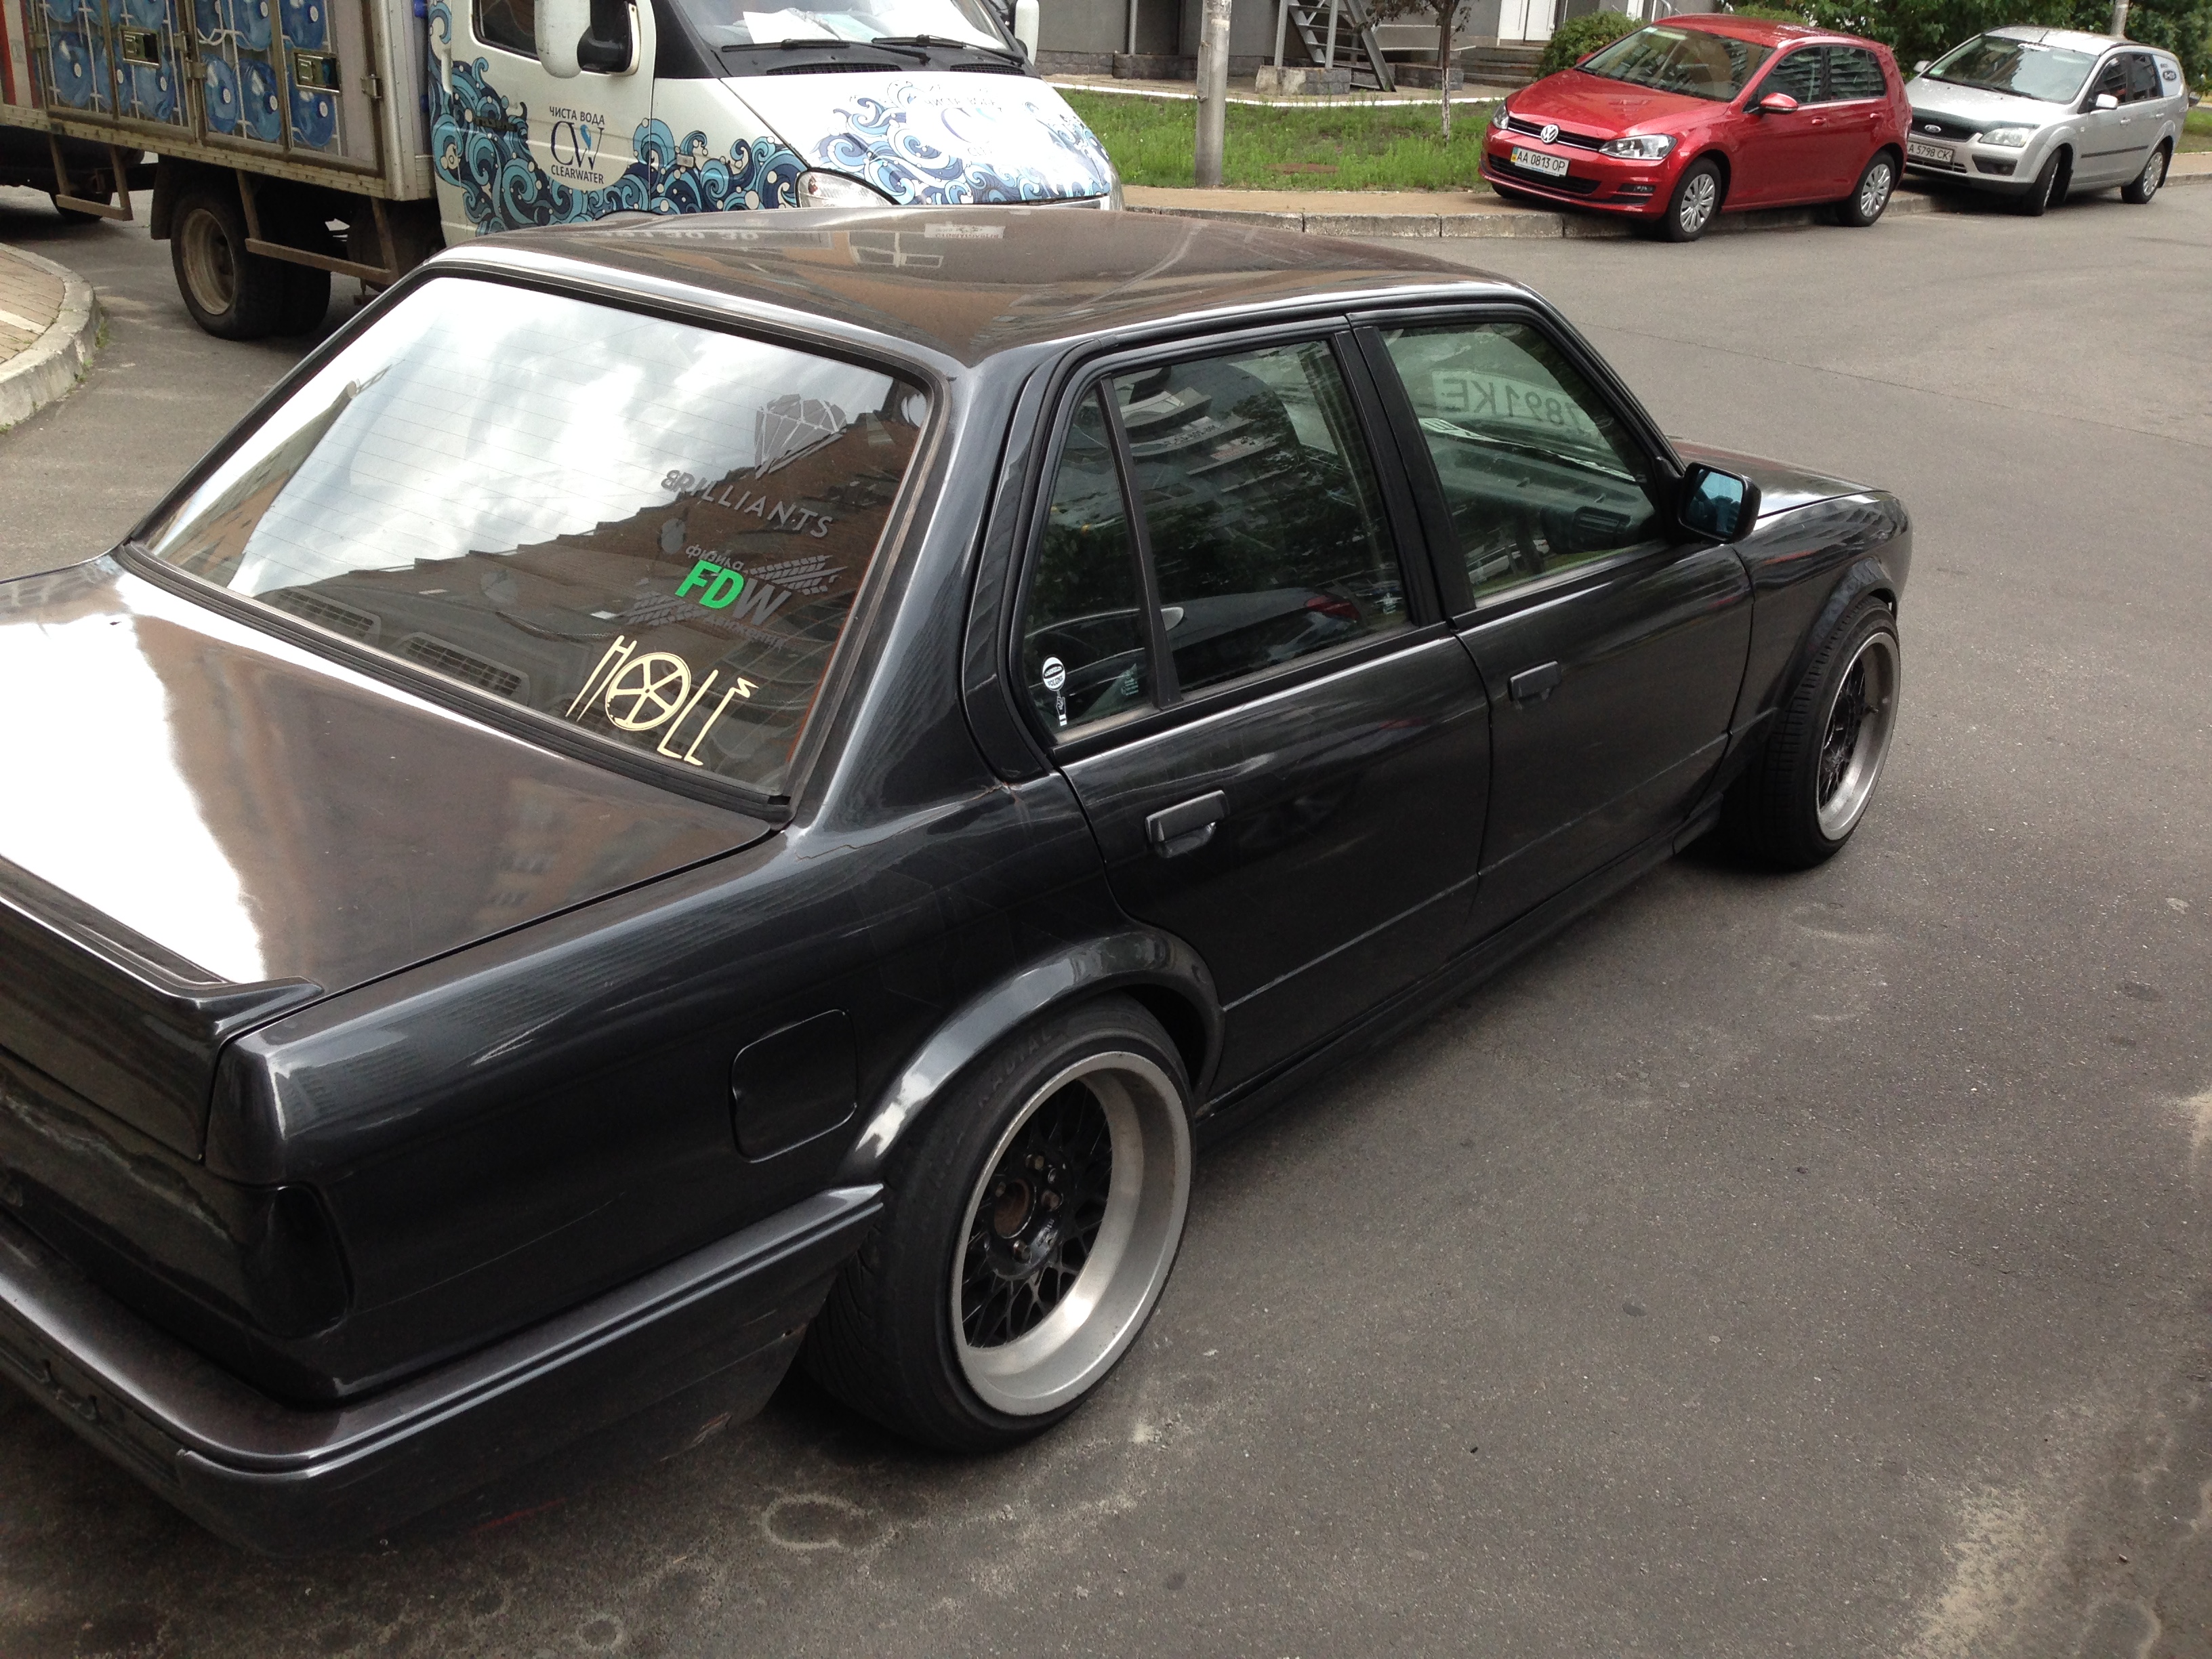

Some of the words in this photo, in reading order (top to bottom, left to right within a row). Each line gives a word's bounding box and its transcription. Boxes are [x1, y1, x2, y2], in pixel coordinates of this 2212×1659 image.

[549, 106, 577, 120] ЧИСТА
[580, 111, 605, 125] ВОДА
[1517, 150, 1528, 163] AA
[1531, 154, 1551, 169] 0813
[1552, 159, 1565, 171] OP
[1917, 145, 1936, 157] 5798
[1938, 150, 1950, 160] CK
[551, 164, 605, 184] CLEARWATER
[660, 469, 834, 538] BRILLIANTS
[674, 559, 792, 626] FDW
